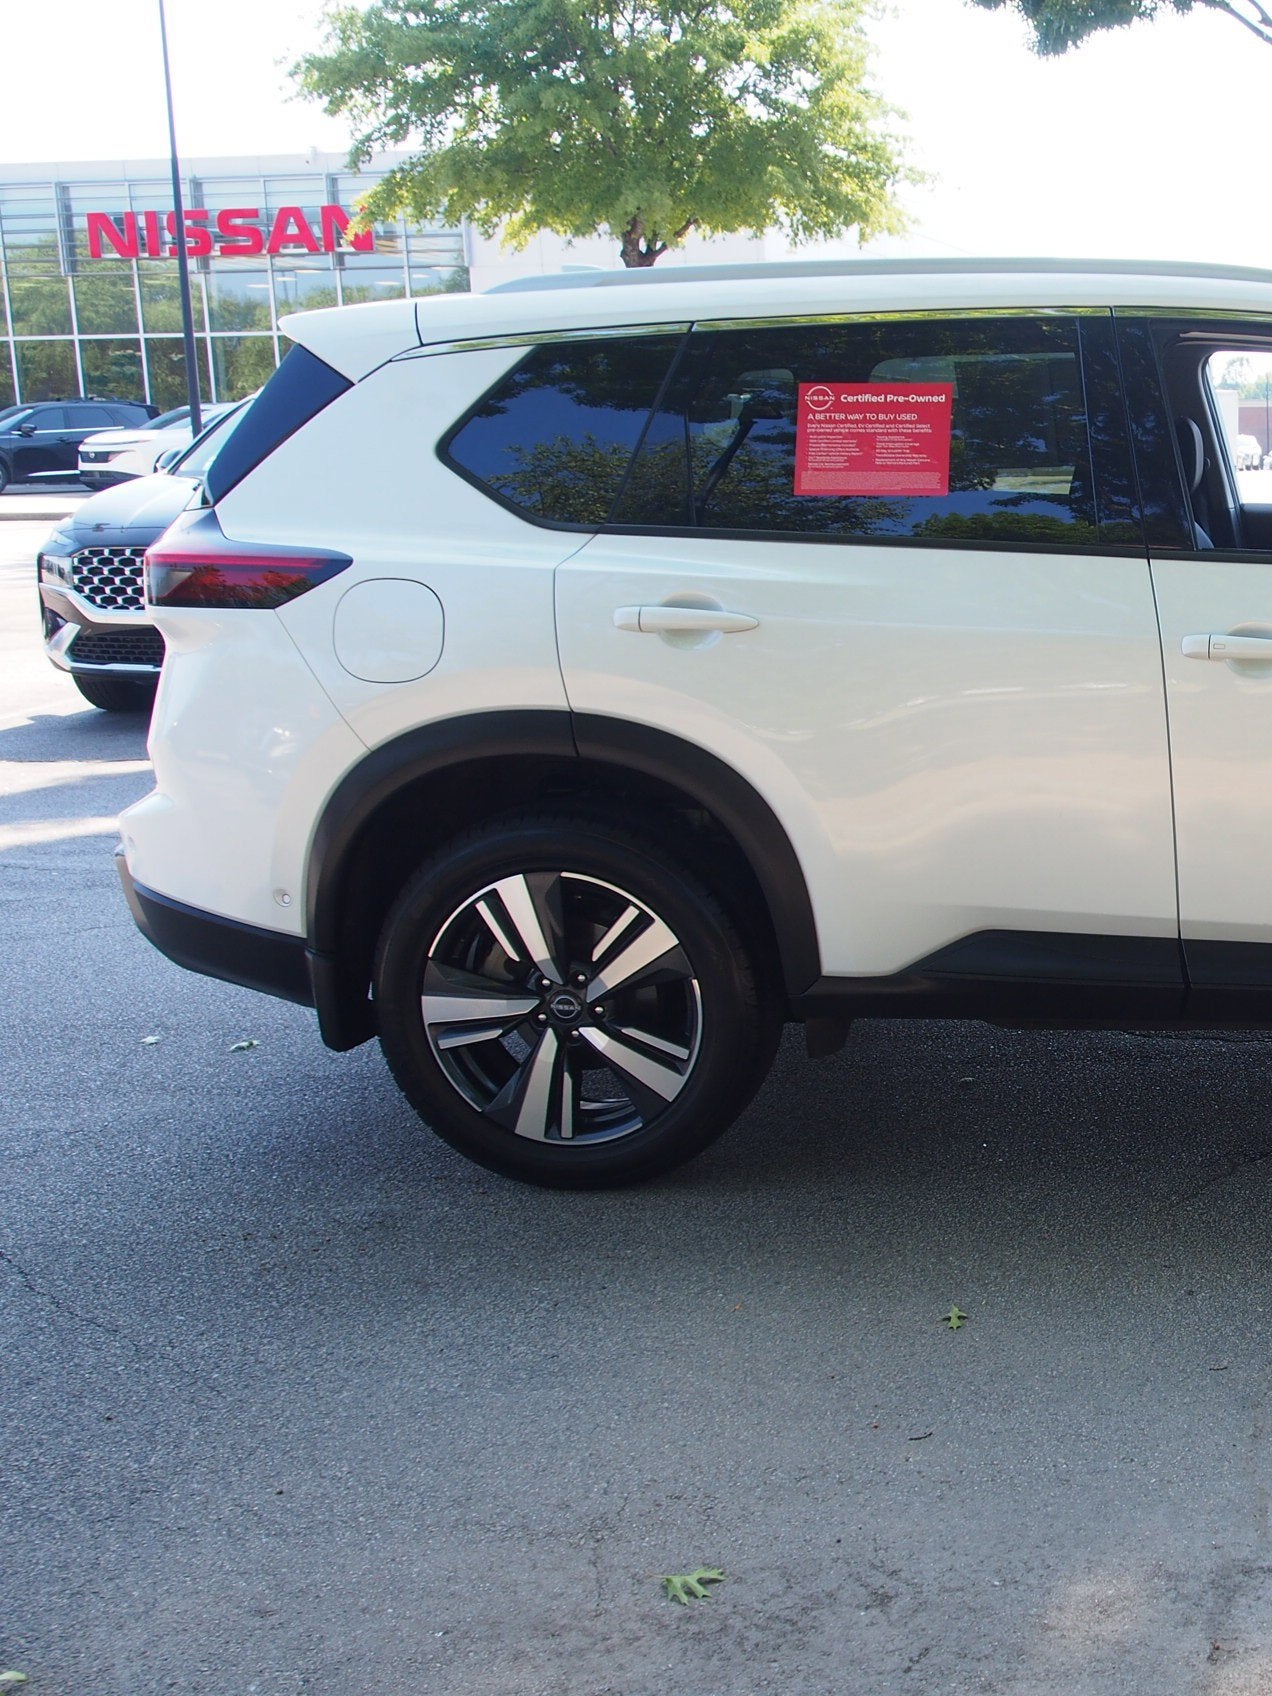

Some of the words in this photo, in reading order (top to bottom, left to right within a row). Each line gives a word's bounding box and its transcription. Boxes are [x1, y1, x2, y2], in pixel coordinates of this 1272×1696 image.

[86, 204, 375, 258] NISSAN
[841, 394, 885, 402] Certified
[887, 394, 946, 402] Pre-Owned
